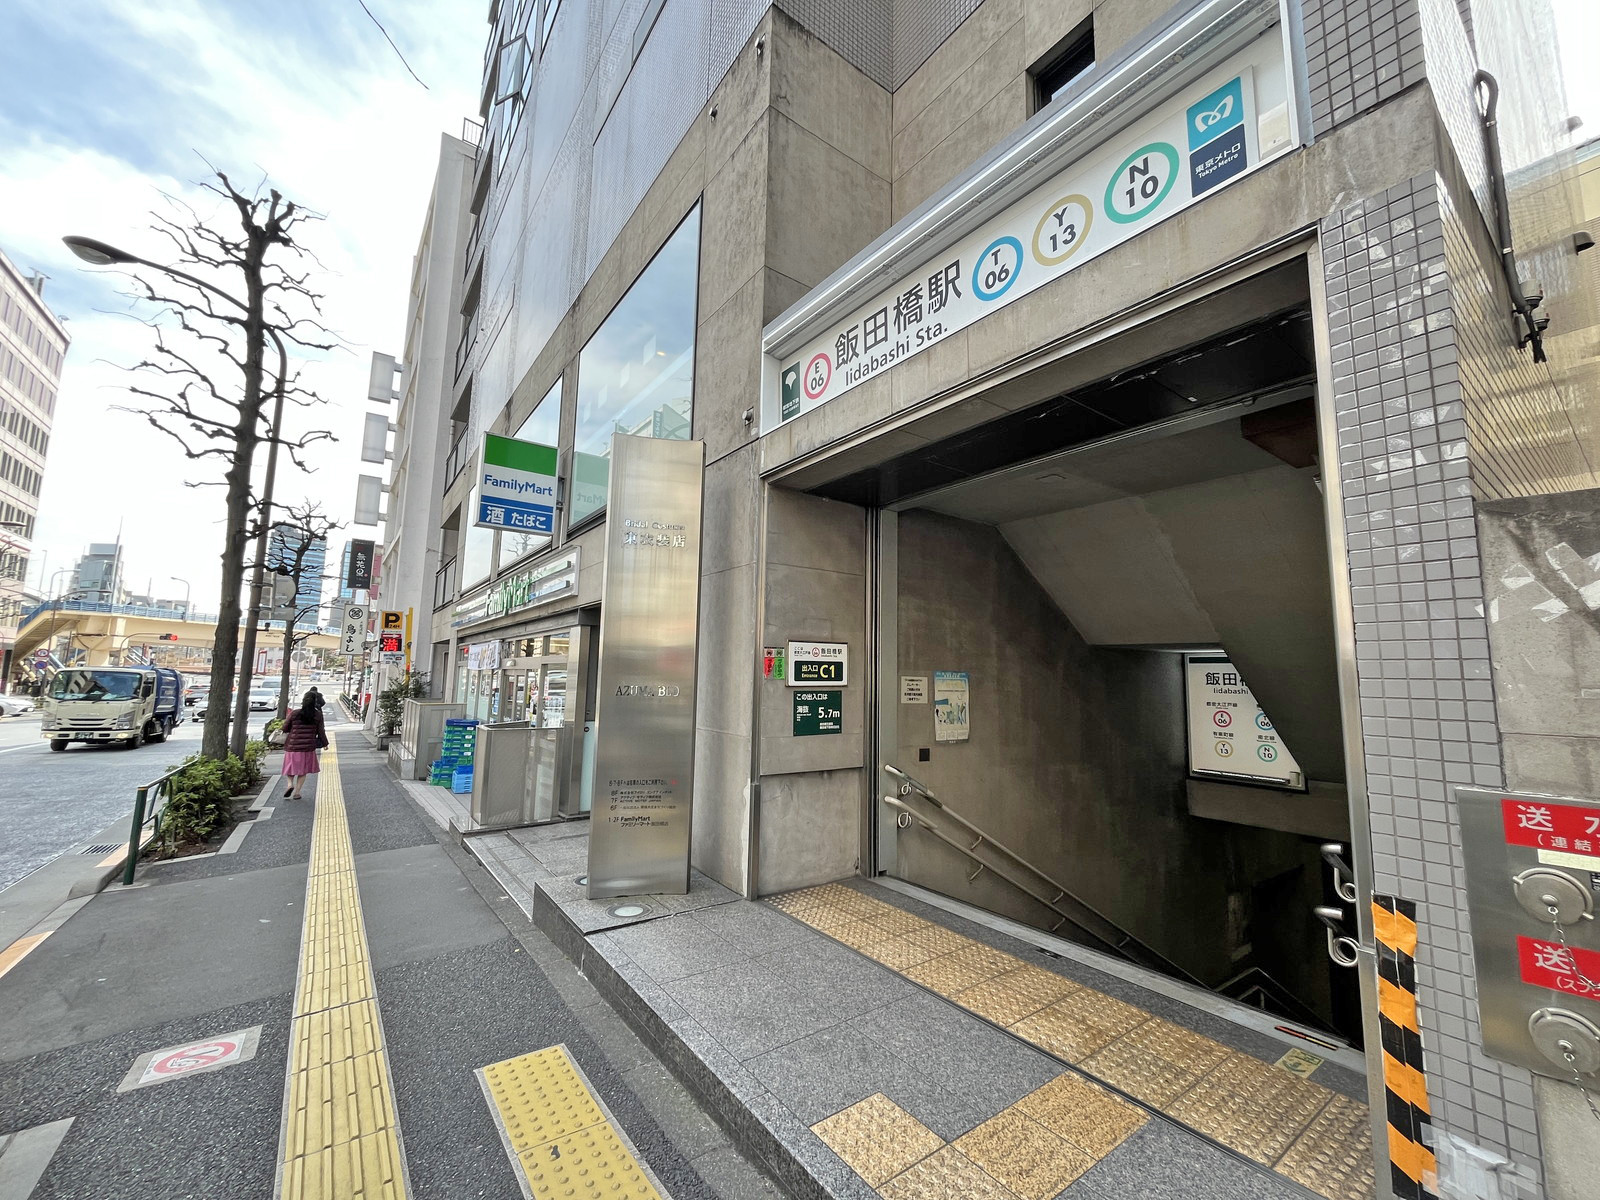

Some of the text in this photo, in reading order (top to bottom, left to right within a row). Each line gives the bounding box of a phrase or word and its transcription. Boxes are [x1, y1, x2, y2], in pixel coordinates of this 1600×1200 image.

[1195, 142, 1241, 174] 東京メトロ
[1198, 153, 1239, 179] Tokyo Metro
[1129, 157, 1149, 184] N
[1125, 175, 1159, 208] 10
[1053, 207, 1068, 228] Y
[1049, 223, 1077, 252] 13
[991, 248, 1001, 267] T
[985, 263, 1010, 290] 06
[834, 258, 962, 371] 飯田橋駅
[845, 321, 948, 387] Iidabashi Sta.
[814, 361, 820, 375] E
[810, 374, 825, 391] 06
[484, 474, 553, 497] FamilyMart
[486, 505, 547, 529] 酒 たばこ
[625, 519, 648, 529] Bridal
[485, 571, 531, 617] FamilyMart
[384, 612, 400, 628] P
[383, 638, 398, 652] 満
[801, 664, 819, 672] 出入口
[820, 664, 835, 678] C1
[1205, 672, 1245, 686] 飯田
[615, 685, 655, 697] AZUMA
[796, 693, 828, 701] この出入口は
[1213, 687, 1249, 695] Iidabashi
[818, 706, 840, 719] 5.7m
[620, 815, 651, 823] FamilyMart
[1537, 833, 1600, 853] (連結
[1533, 942, 1572, 975] 送
